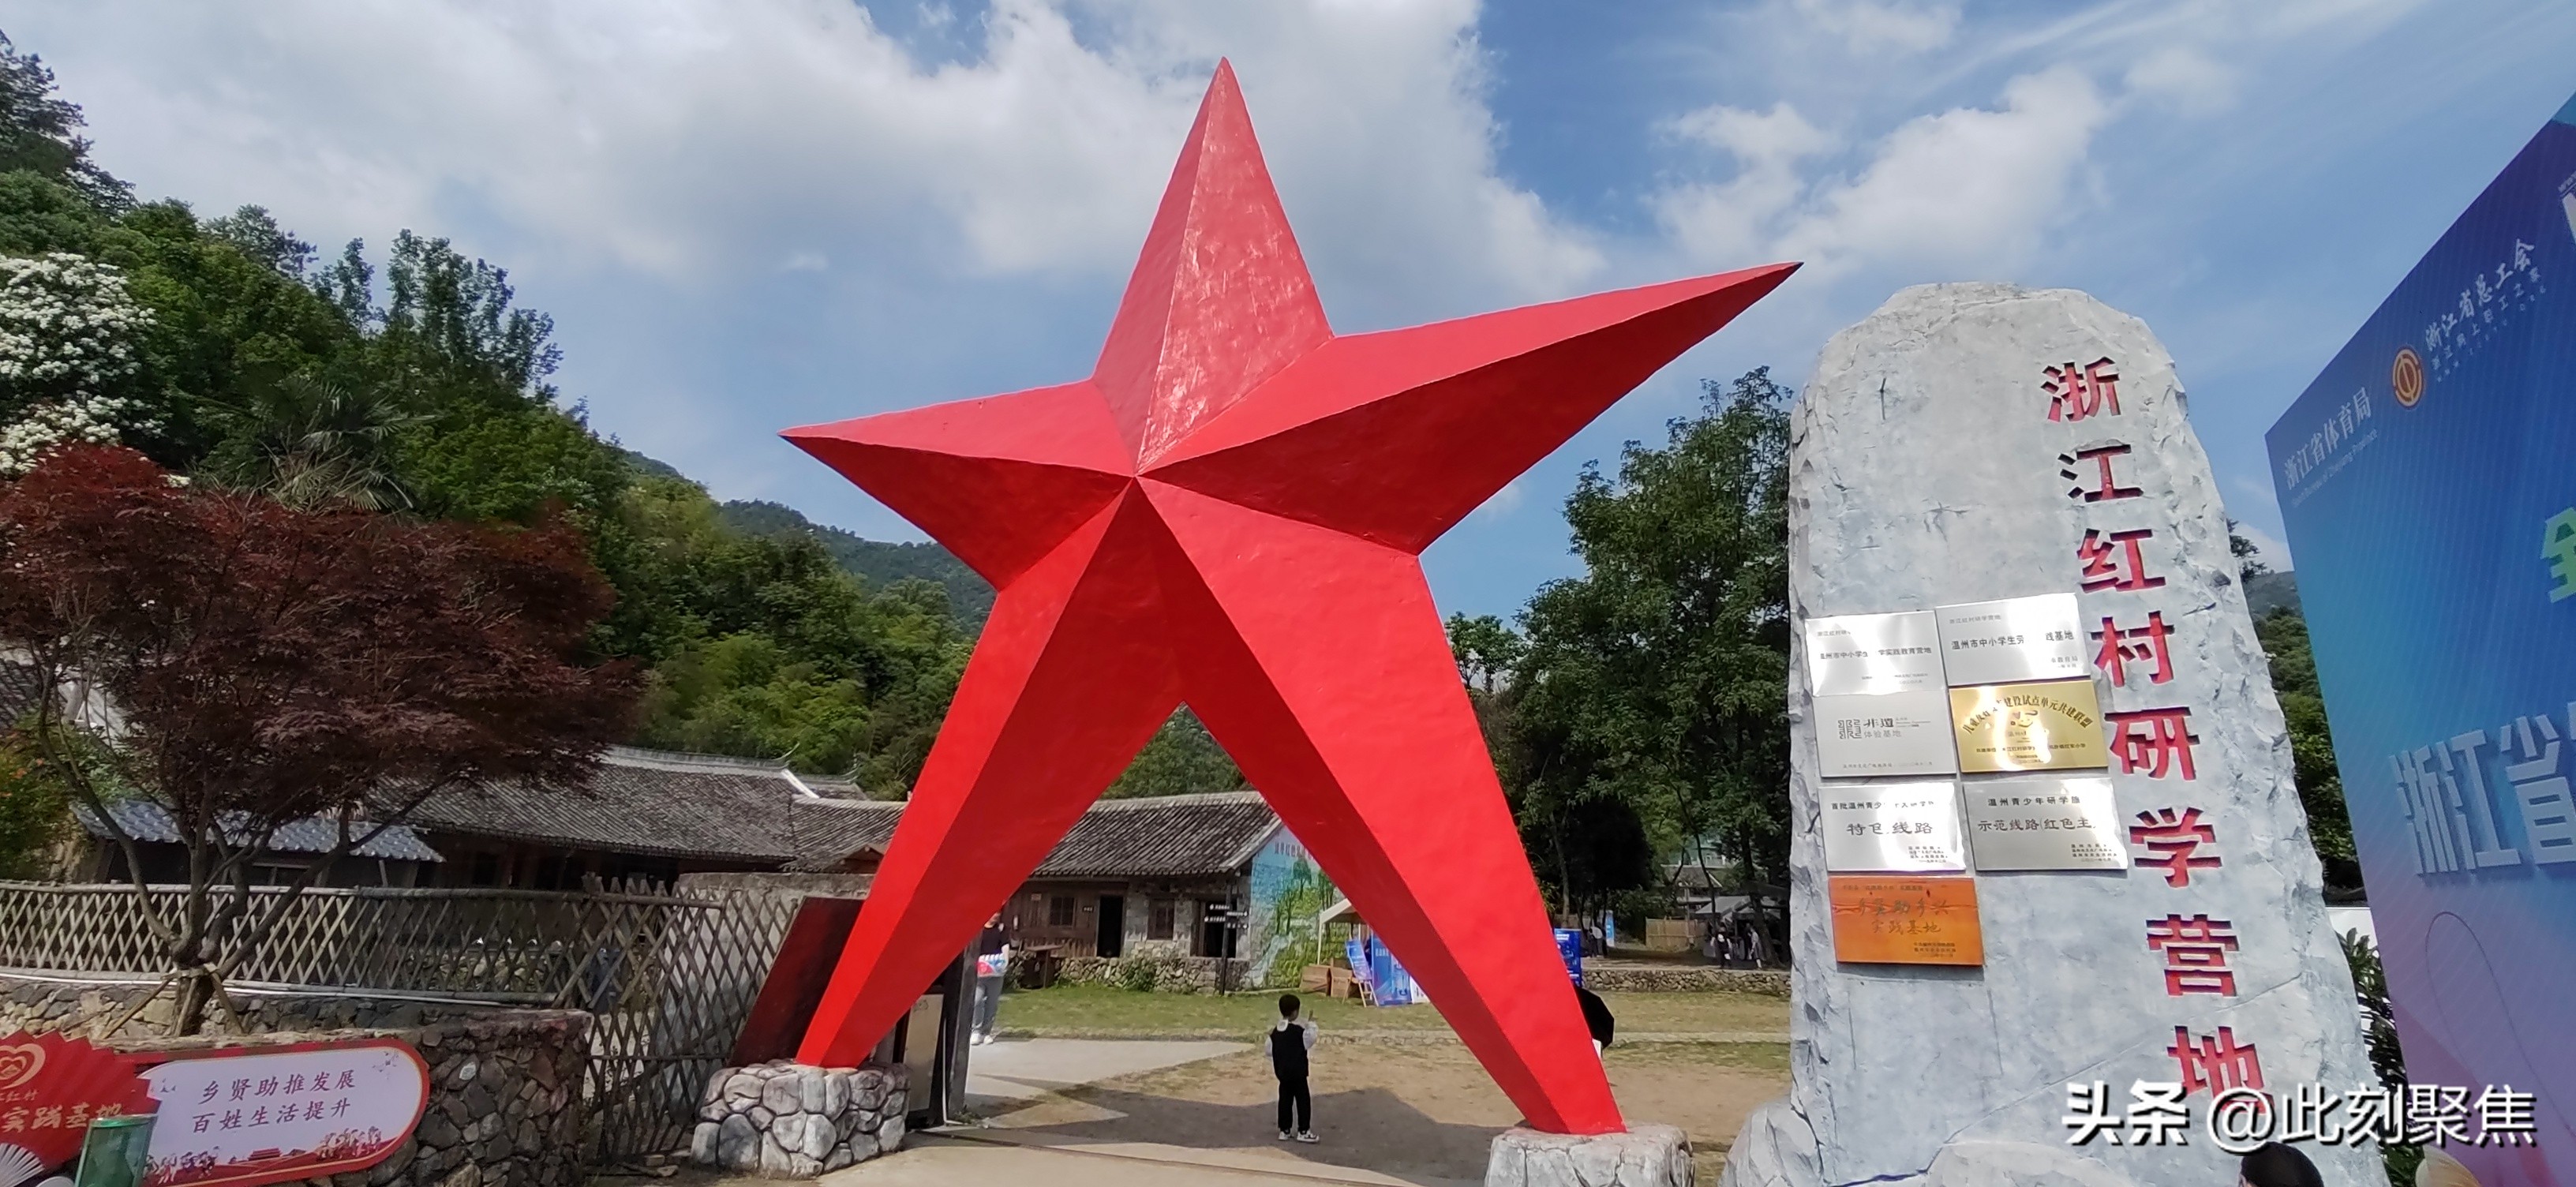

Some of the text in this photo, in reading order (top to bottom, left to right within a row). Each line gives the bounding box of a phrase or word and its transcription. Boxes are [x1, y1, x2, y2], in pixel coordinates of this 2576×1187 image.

[2425, 238, 2534, 352] 浙江省总工会
[2284, 387, 2372, 490] 浙江省体育局
[1863, 730, 1902, 739] 体验基地
[2040, 355, 2274, 1114] 浙江红村研学营地
[2389, 701, 2576, 874] 浙江省
[1870, 919, 1942, 935] 实践基地
[192, 1097, 351, 1134] 百姓生活提升
[199, 1069, 357, 1106] 乡贤助推发展
